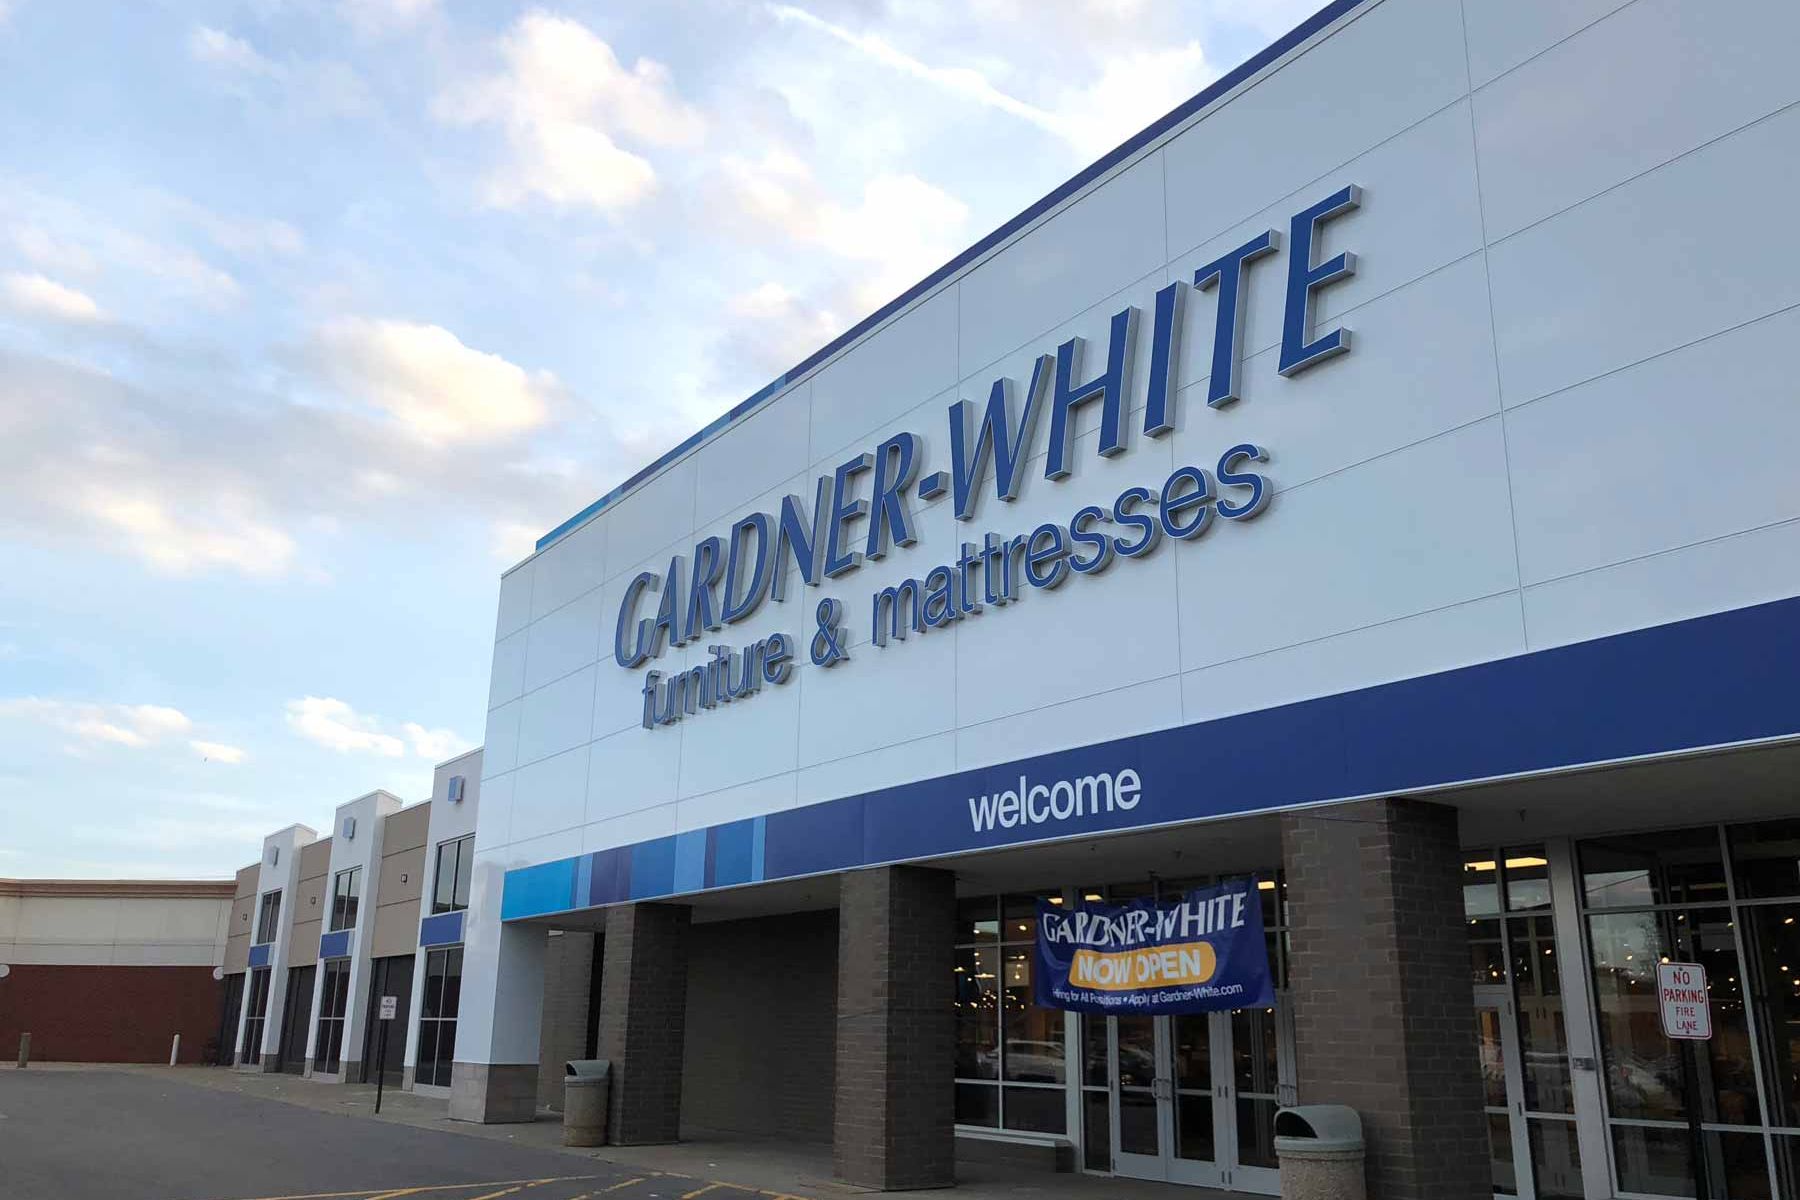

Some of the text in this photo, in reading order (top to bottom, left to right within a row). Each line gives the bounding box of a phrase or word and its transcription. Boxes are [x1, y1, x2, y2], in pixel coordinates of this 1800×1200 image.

[614, 184, 1361, 669] GARDNER-WHITE
[642, 443, 1273, 729] furniture & mattresses
[968, 768, 1142, 832] welcome
[1043, 892, 1247, 947] GARDNER-WHITE
[1078, 949, 1200, 984] NOW OPEN
[1673, 971, 1690, 985] NO
[1128, 994, 1150, 1006] Apply
[1152, 993, 1160, 1004] at
[1159, 984, 1243, 1003] Gardner-White.com
[1664, 989, 1704, 1003] PARKING
[1676, 1006, 1695, 1016] FIRE
[1676, 1021, 1698, 1030] LANE
